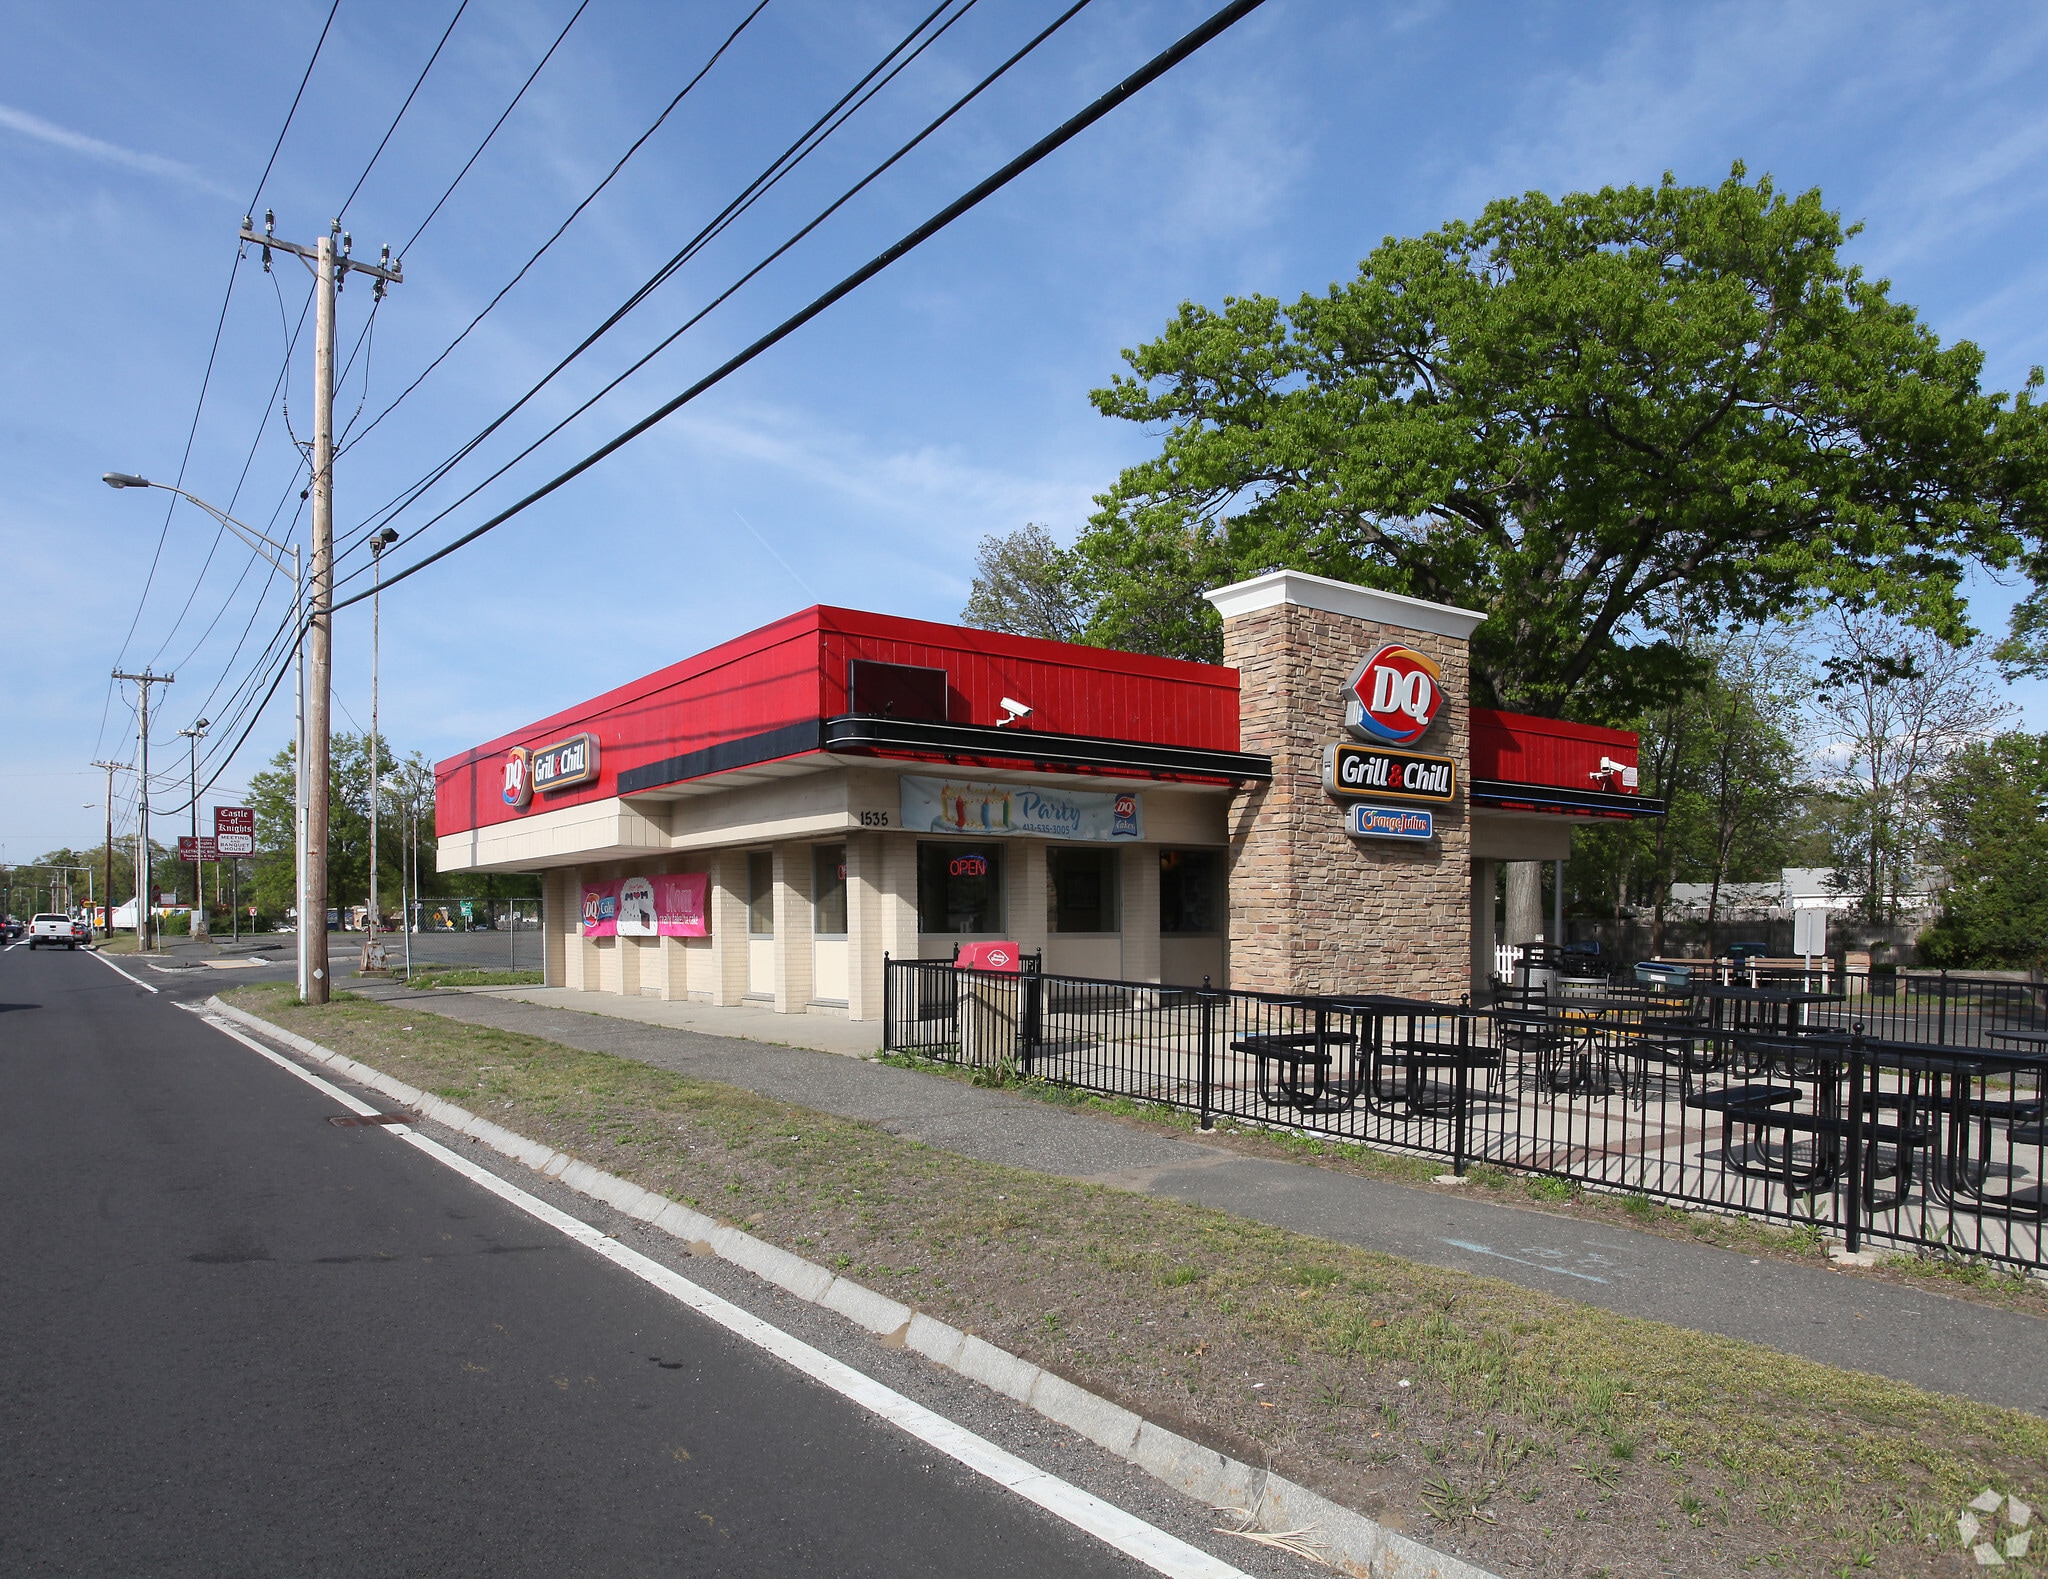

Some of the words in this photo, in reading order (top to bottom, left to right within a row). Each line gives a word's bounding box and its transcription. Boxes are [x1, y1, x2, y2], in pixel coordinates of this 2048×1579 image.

[1371, 665, 1432, 725] DQ
[504, 759, 523, 791] DQ
[221, 809, 248, 818] Castle
[1015, 791, 1080, 831] Party
[1117, 801, 1133, 814] DQ
[230, 817, 239, 825] of
[860, 811, 889, 826] 1535
[1116, 820, 1134, 830] Cakes
[218, 823, 252, 833] Knights
[950, 860, 986, 876] OPEN
[585, 900, 597, 918] DQ
